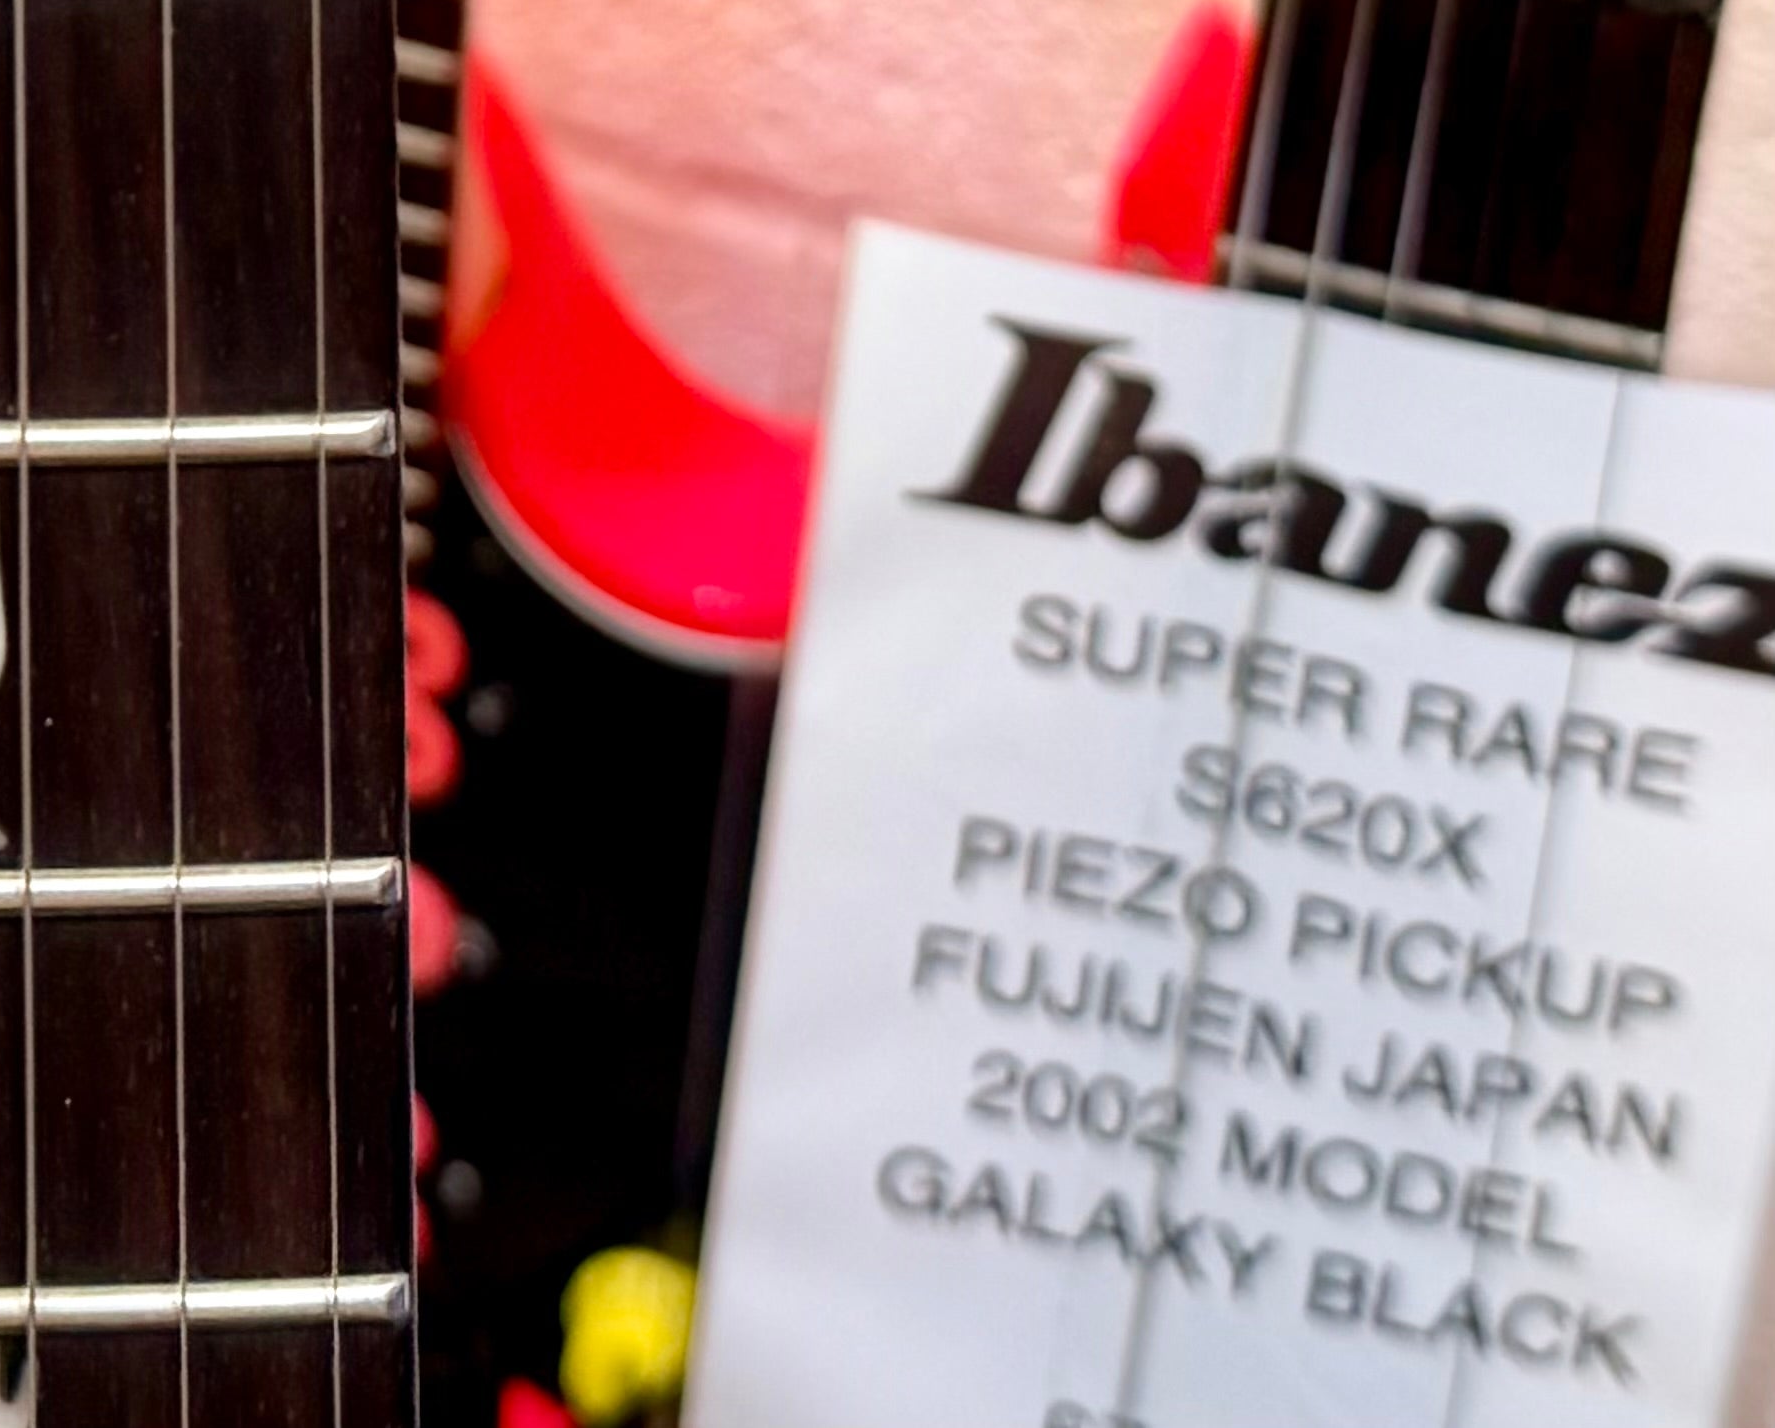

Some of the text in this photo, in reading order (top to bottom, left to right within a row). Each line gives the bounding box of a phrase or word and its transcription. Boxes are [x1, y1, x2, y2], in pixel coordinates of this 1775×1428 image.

[903, 314, 1775, 676] Ibanez
[1012, 592, 1703, 812] SUPER RARE
[953, 815, 1685, 1036] PIEZO PICKUP
[1175, 742, 1492, 892] S620X
[966, 1048, 1583, 1262] 2002 MODEL
[1342, 1028, 1685, 1165] JAPAN
[875, 1146, 1647, 1384] GALAXY BLACK
